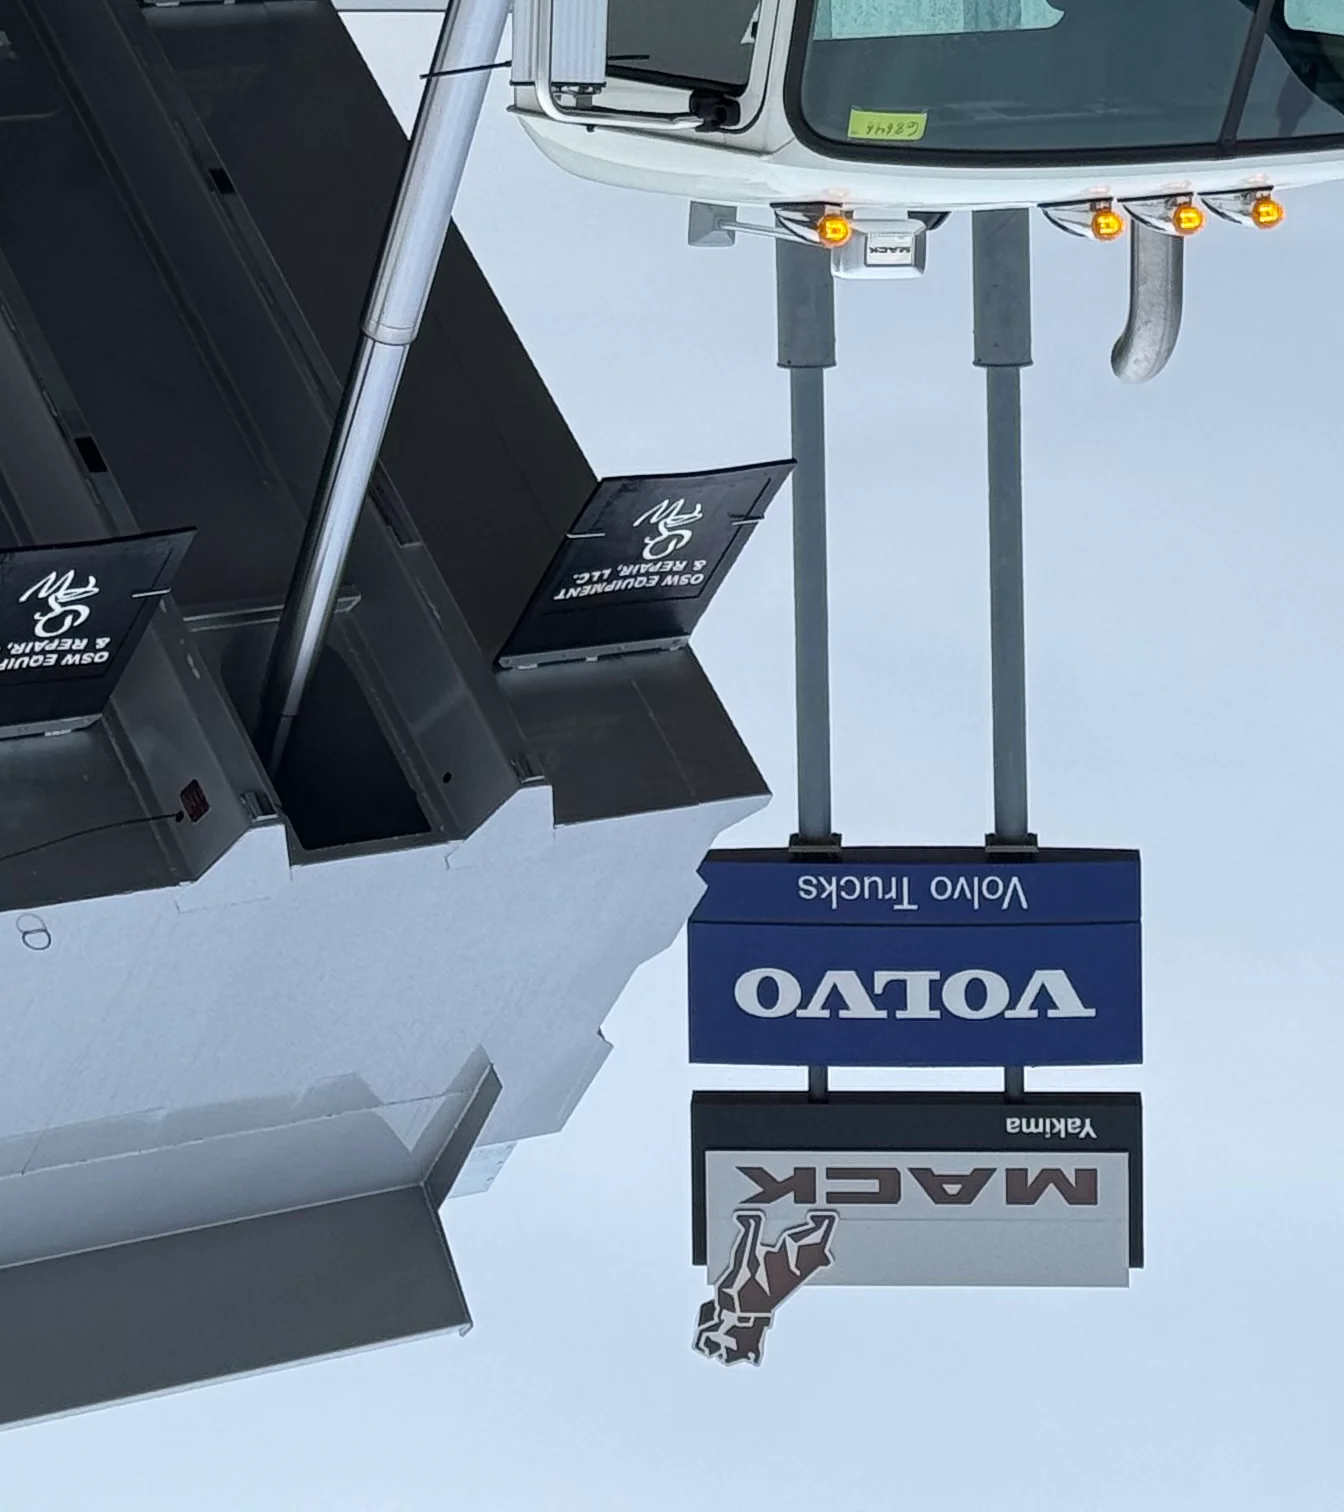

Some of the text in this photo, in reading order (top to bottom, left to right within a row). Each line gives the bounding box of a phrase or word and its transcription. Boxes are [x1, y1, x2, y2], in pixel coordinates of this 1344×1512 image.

[869, 246, 911, 254] MACK
[572, 559, 707, 584] & REPAIR, LLC.
[553, 572, 705, 600] OSW EQUIPMENT
[6, 637, 89, 654] REPAIR,
[95, 637, 111, 649] &
[61, 650, 110, 665] OSW
[797, 875, 1028, 911] Volvo Trucks
[734, 967, 1096, 1020] VOLVO
[1005, 1117, 1097, 1139] Yakima
[735, 1166, 1098, 1206] MACK
